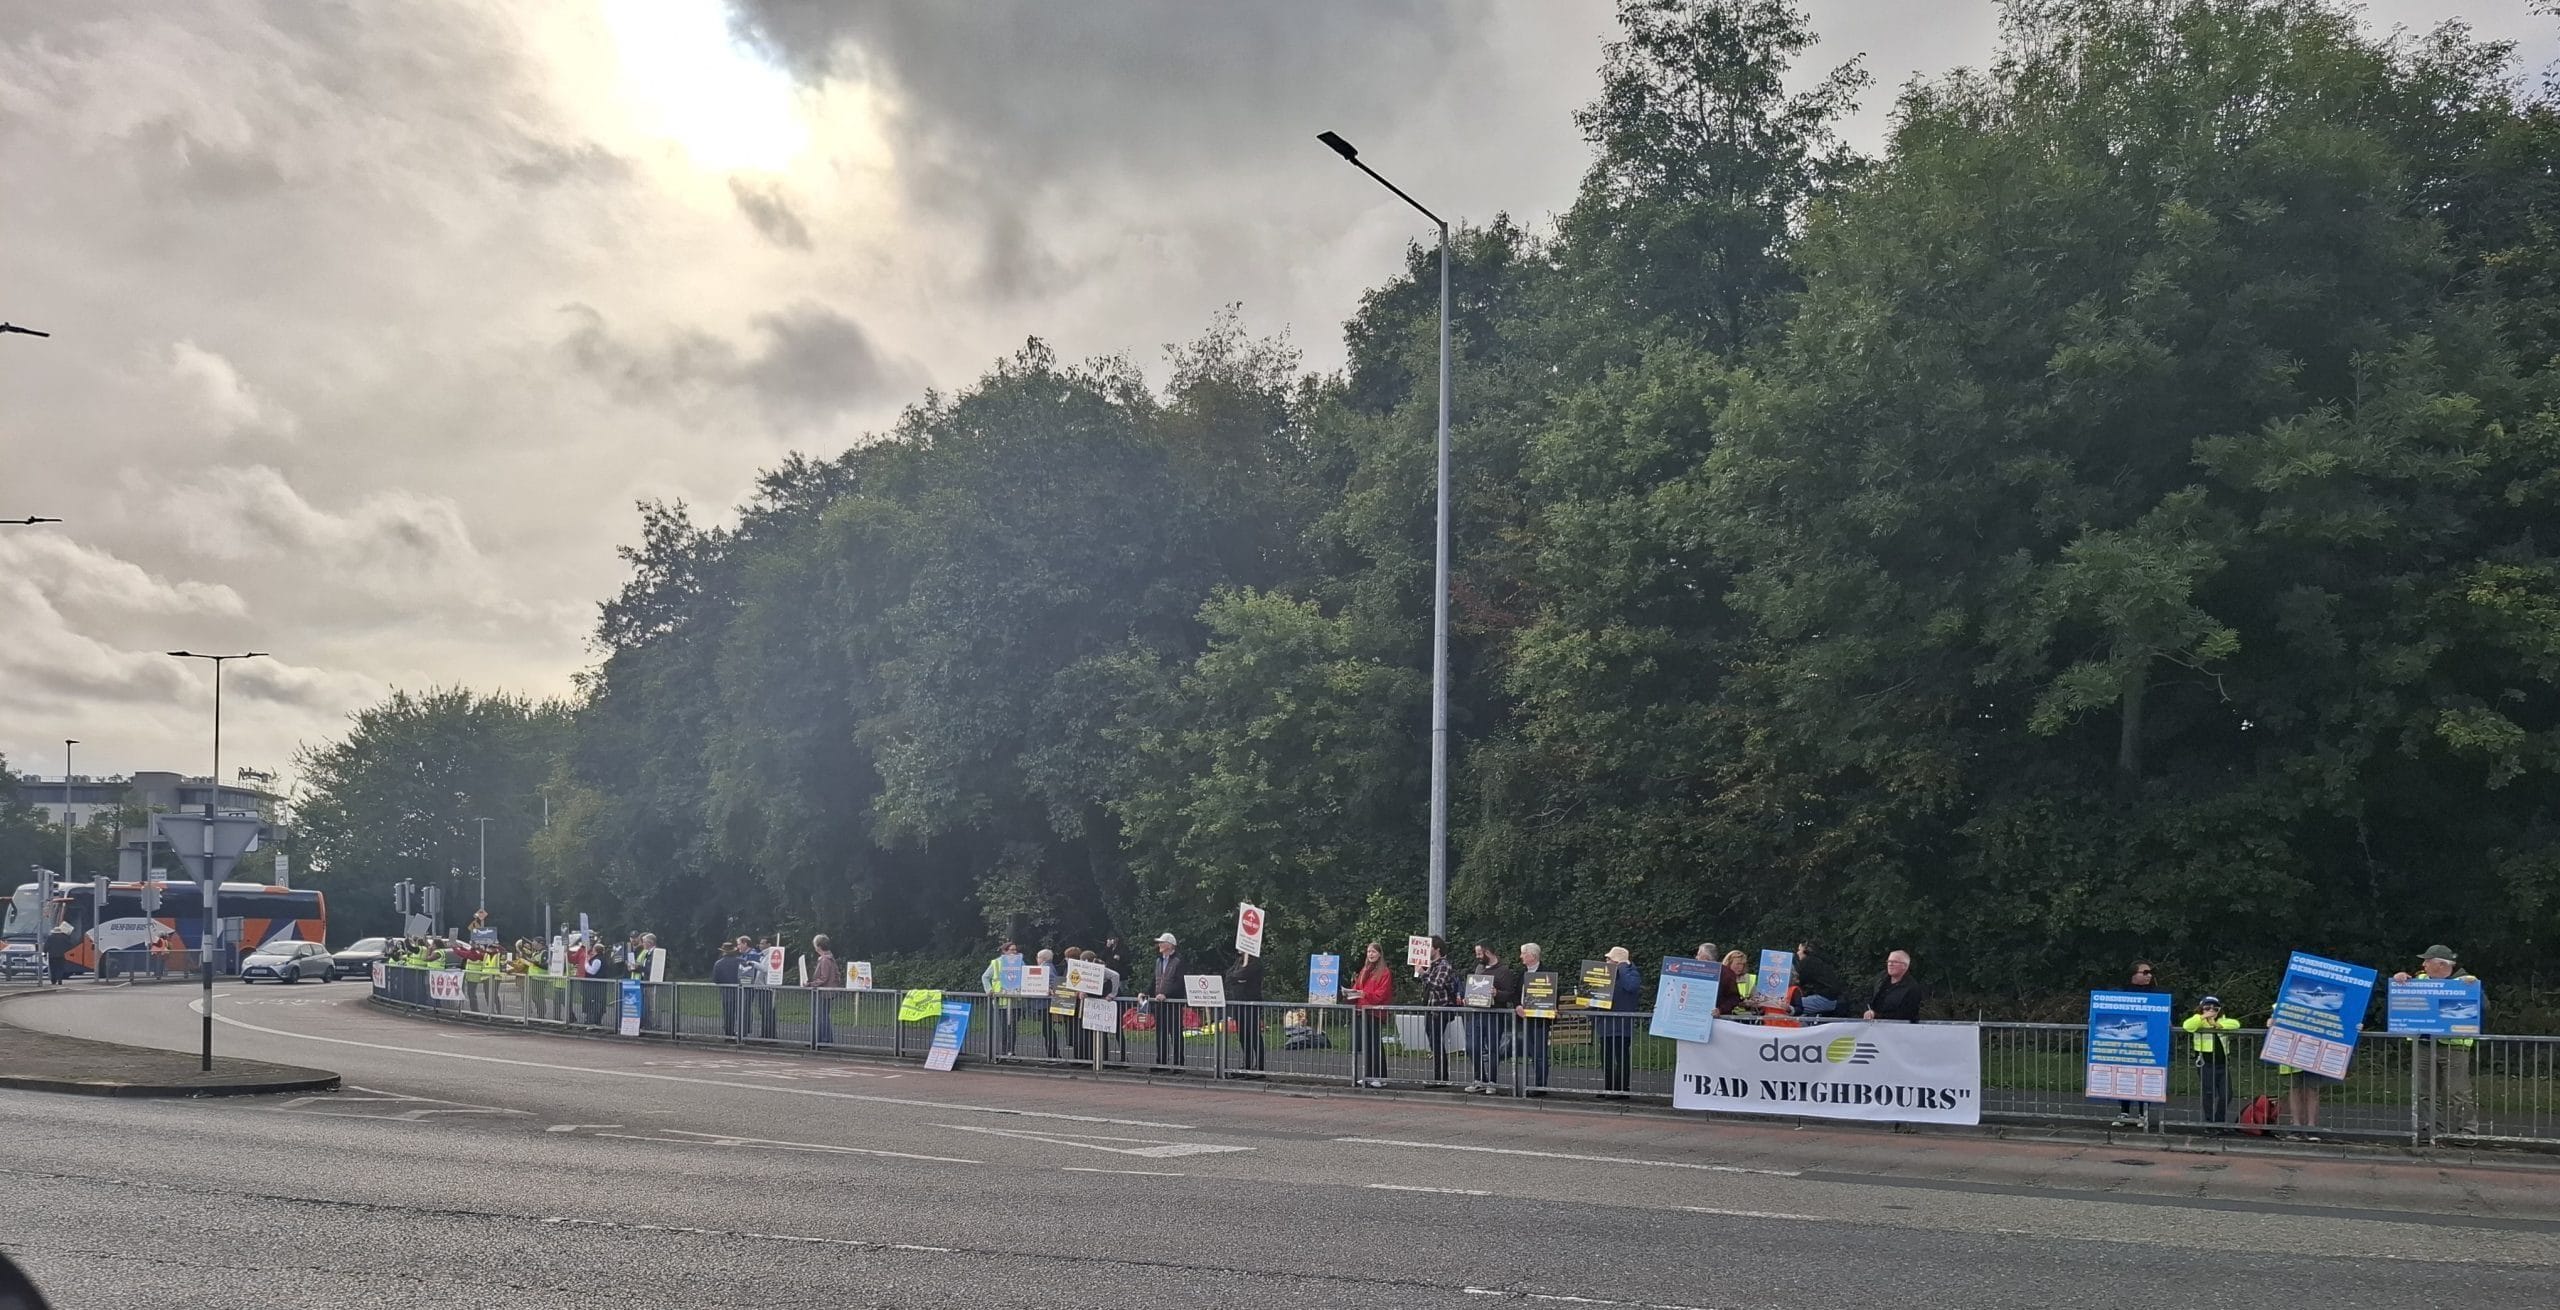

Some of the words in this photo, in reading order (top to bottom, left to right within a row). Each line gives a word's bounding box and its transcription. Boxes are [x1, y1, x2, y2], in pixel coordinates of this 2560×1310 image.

[2292, 955, 2352, 974] COMMUNITY
[2289, 963, 2373, 988] DEMONSTRATION
[2093, 994, 2148, 1003] COMMUNITY
[2391, 988, 2467, 996] DEMONSTRATION
[2092, 1002, 2169, 1013] DEMONSTRATION
[1759, 1037, 1822, 1063] daa
[1682, 1073, 1749, 1099] "BAD
[1759, 1079, 1971, 1110] NEIGHBOURS"
